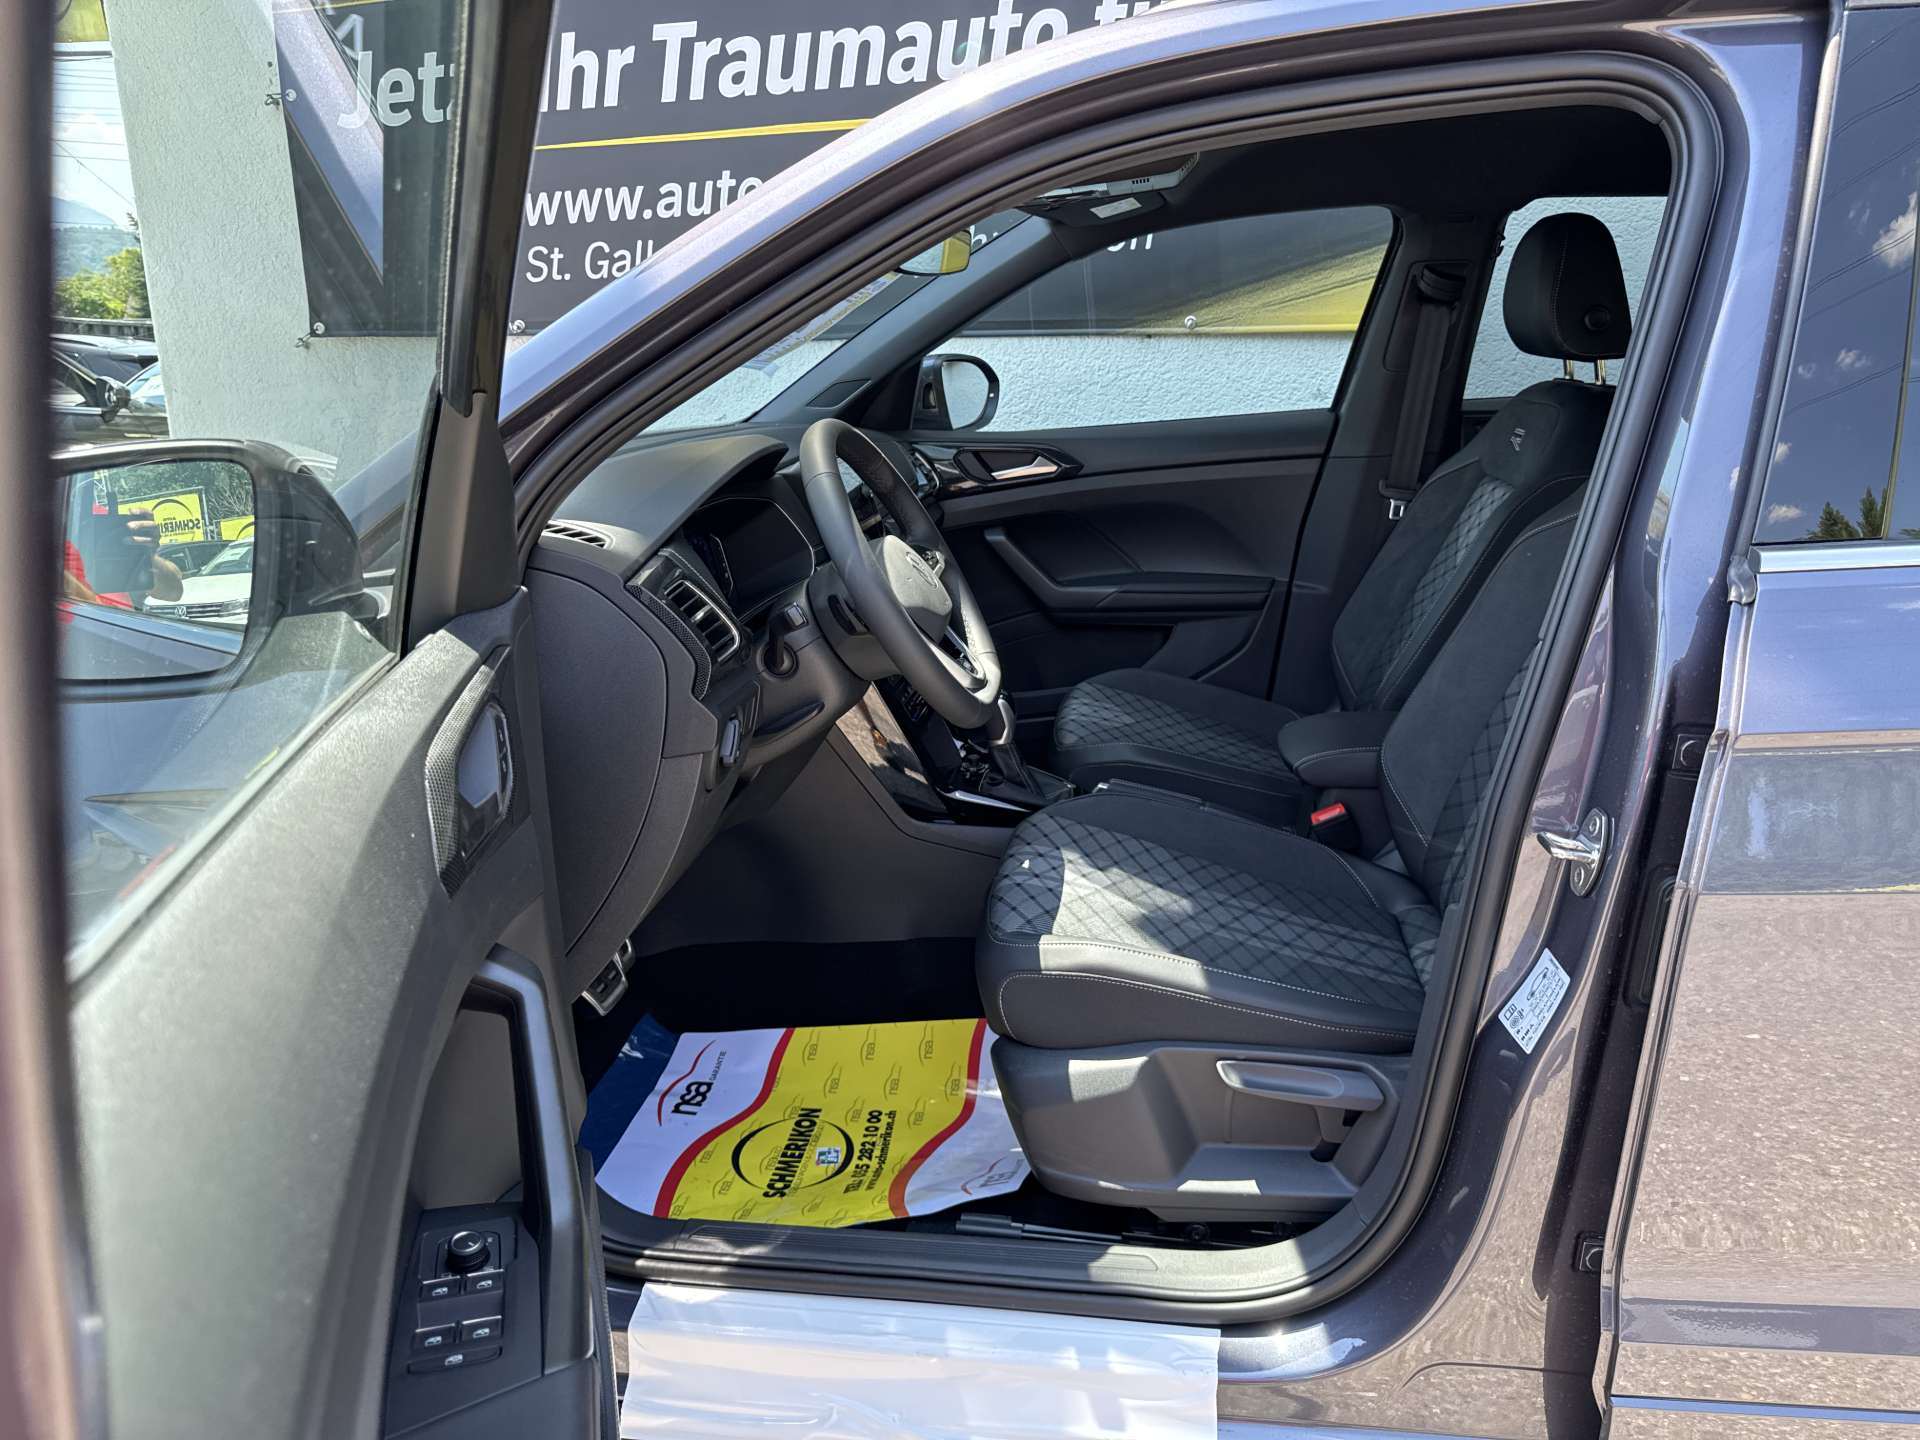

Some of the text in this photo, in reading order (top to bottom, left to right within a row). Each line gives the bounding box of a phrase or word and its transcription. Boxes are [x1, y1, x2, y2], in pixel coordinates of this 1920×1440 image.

[336, 50, 456, 129] Jet
[525, 245, 571, 283] St.
[671, 1081, 714, 1116] nsa
[763, 1107, 822, 1198] SCHMERIKON
